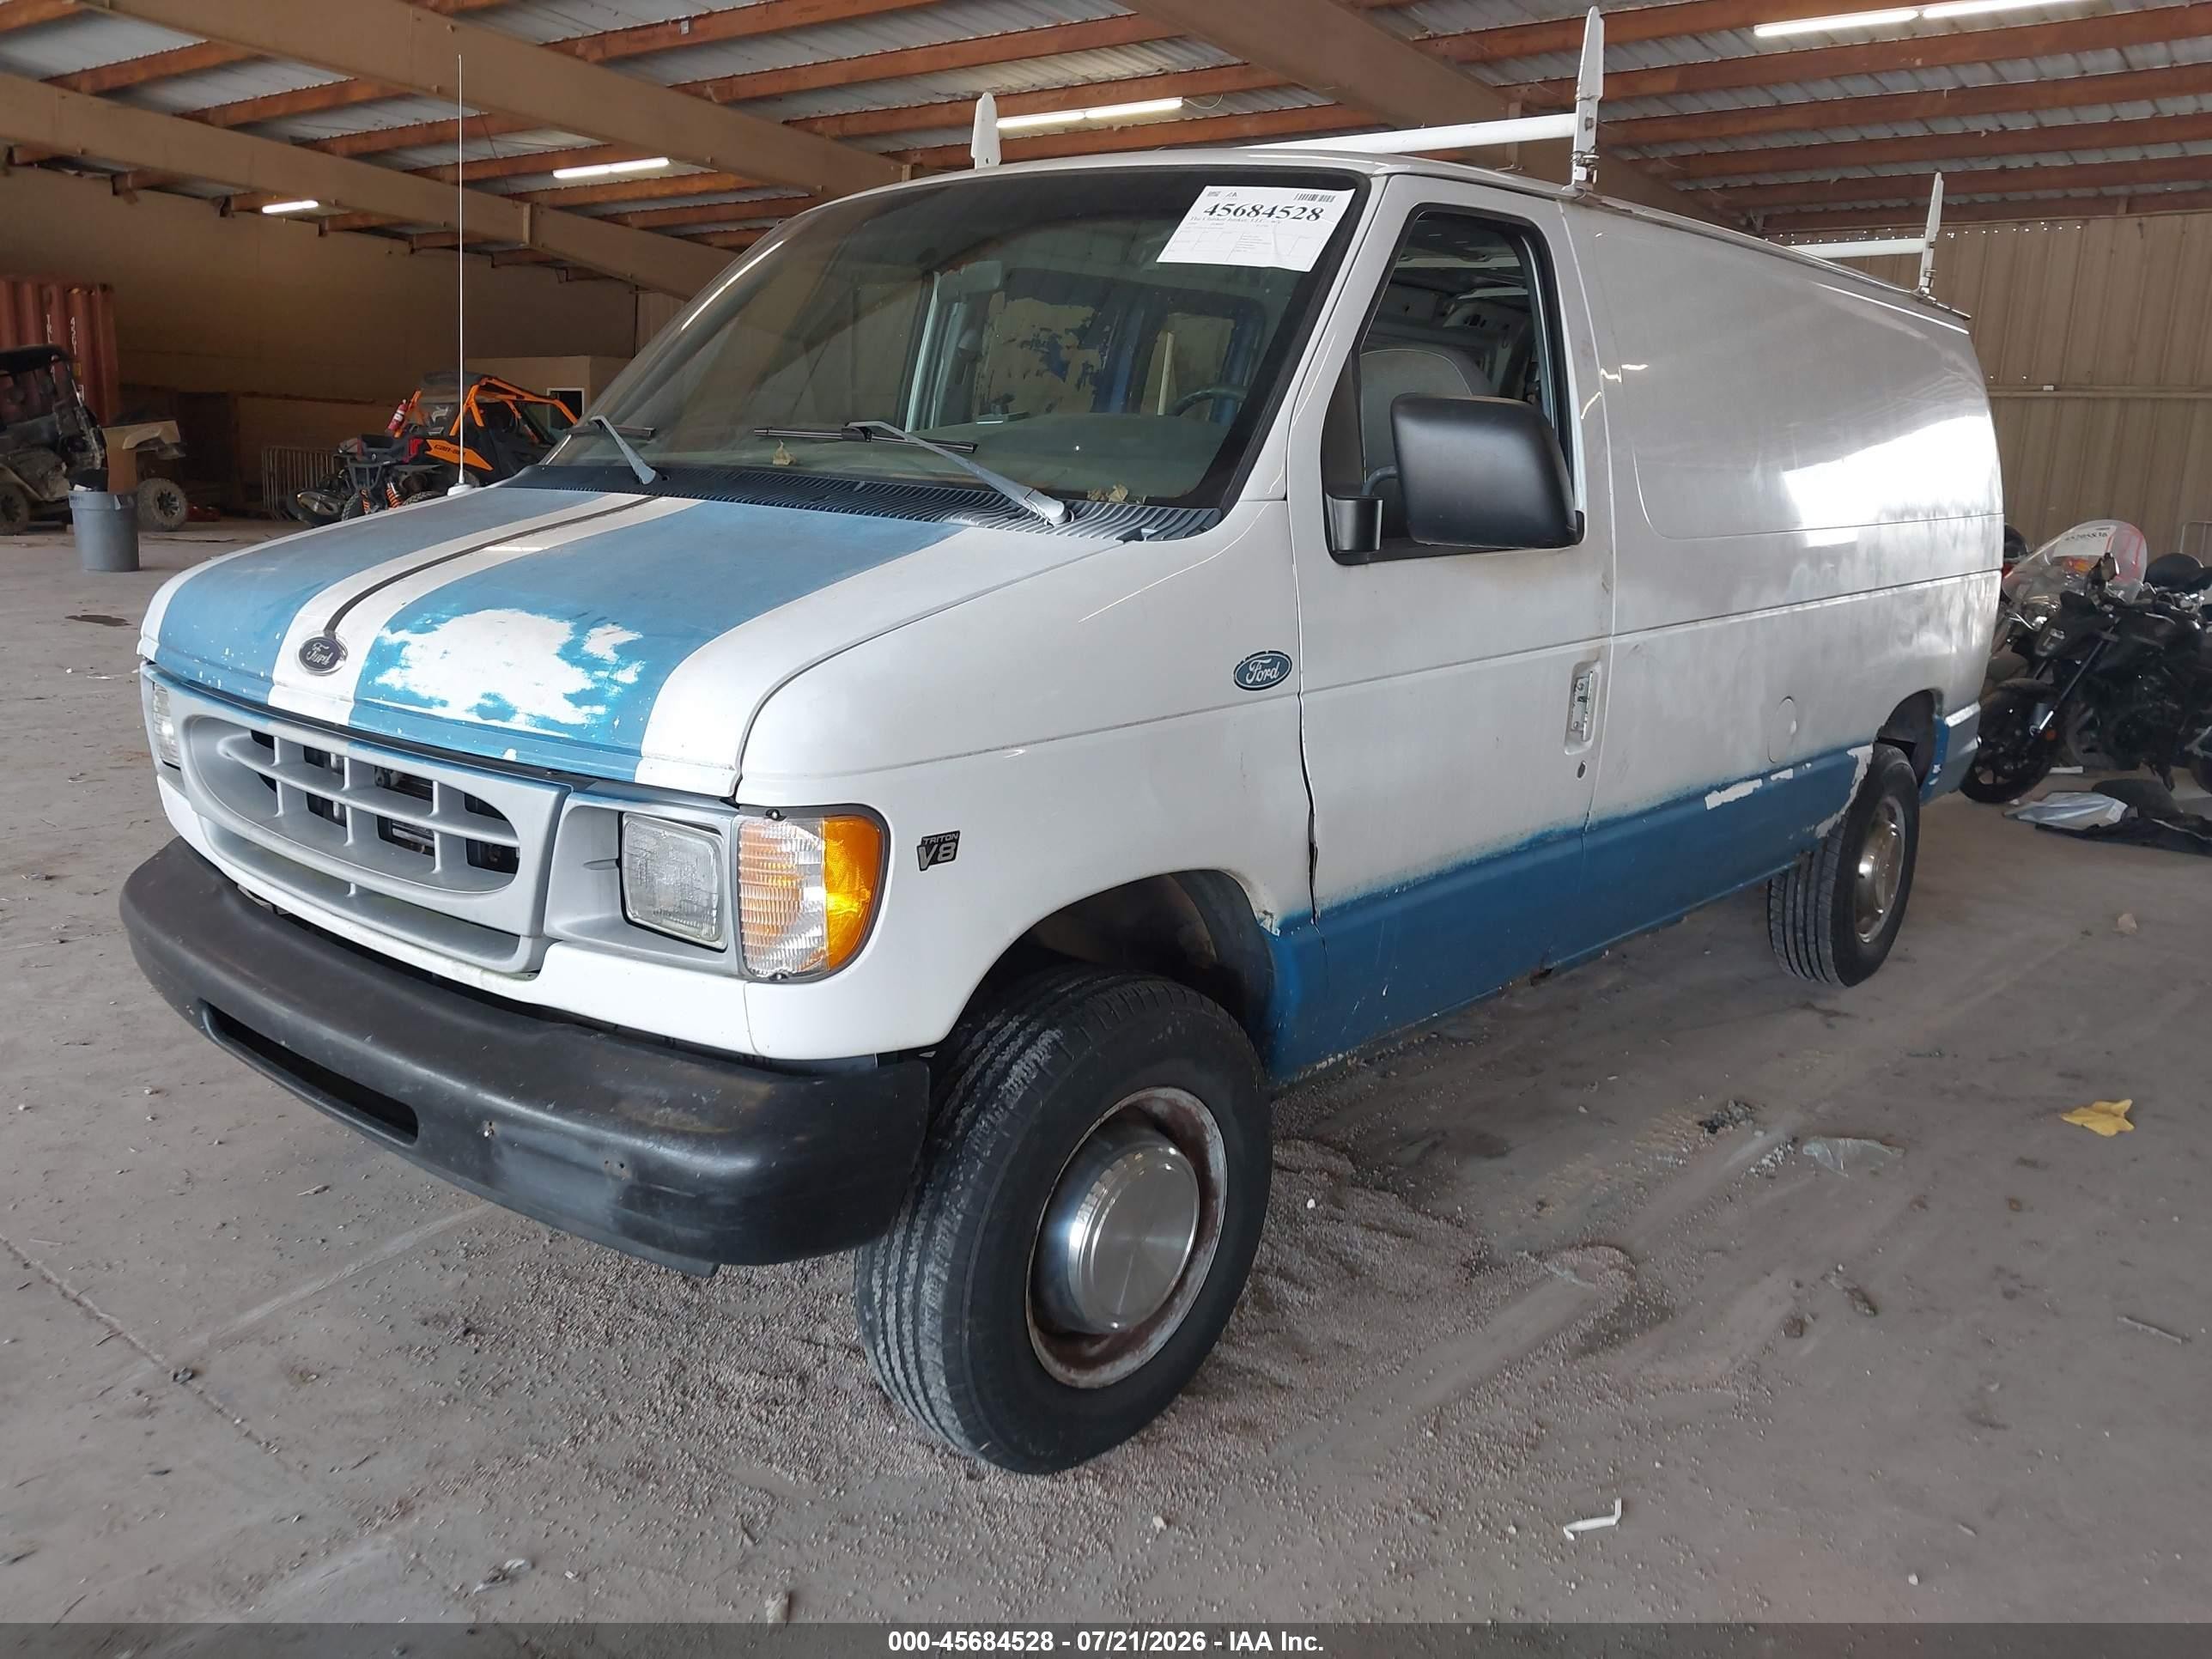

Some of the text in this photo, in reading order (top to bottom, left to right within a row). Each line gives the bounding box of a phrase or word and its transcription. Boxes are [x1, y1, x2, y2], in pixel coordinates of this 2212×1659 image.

[1203, 202, 1325, 222] 45684528
[306, 642, 334, 665] Ford
[1245, 658, 1280, 684] Ford
[922, 832, 959, 845] TRITON
[918, 842, 957, 870] V8
